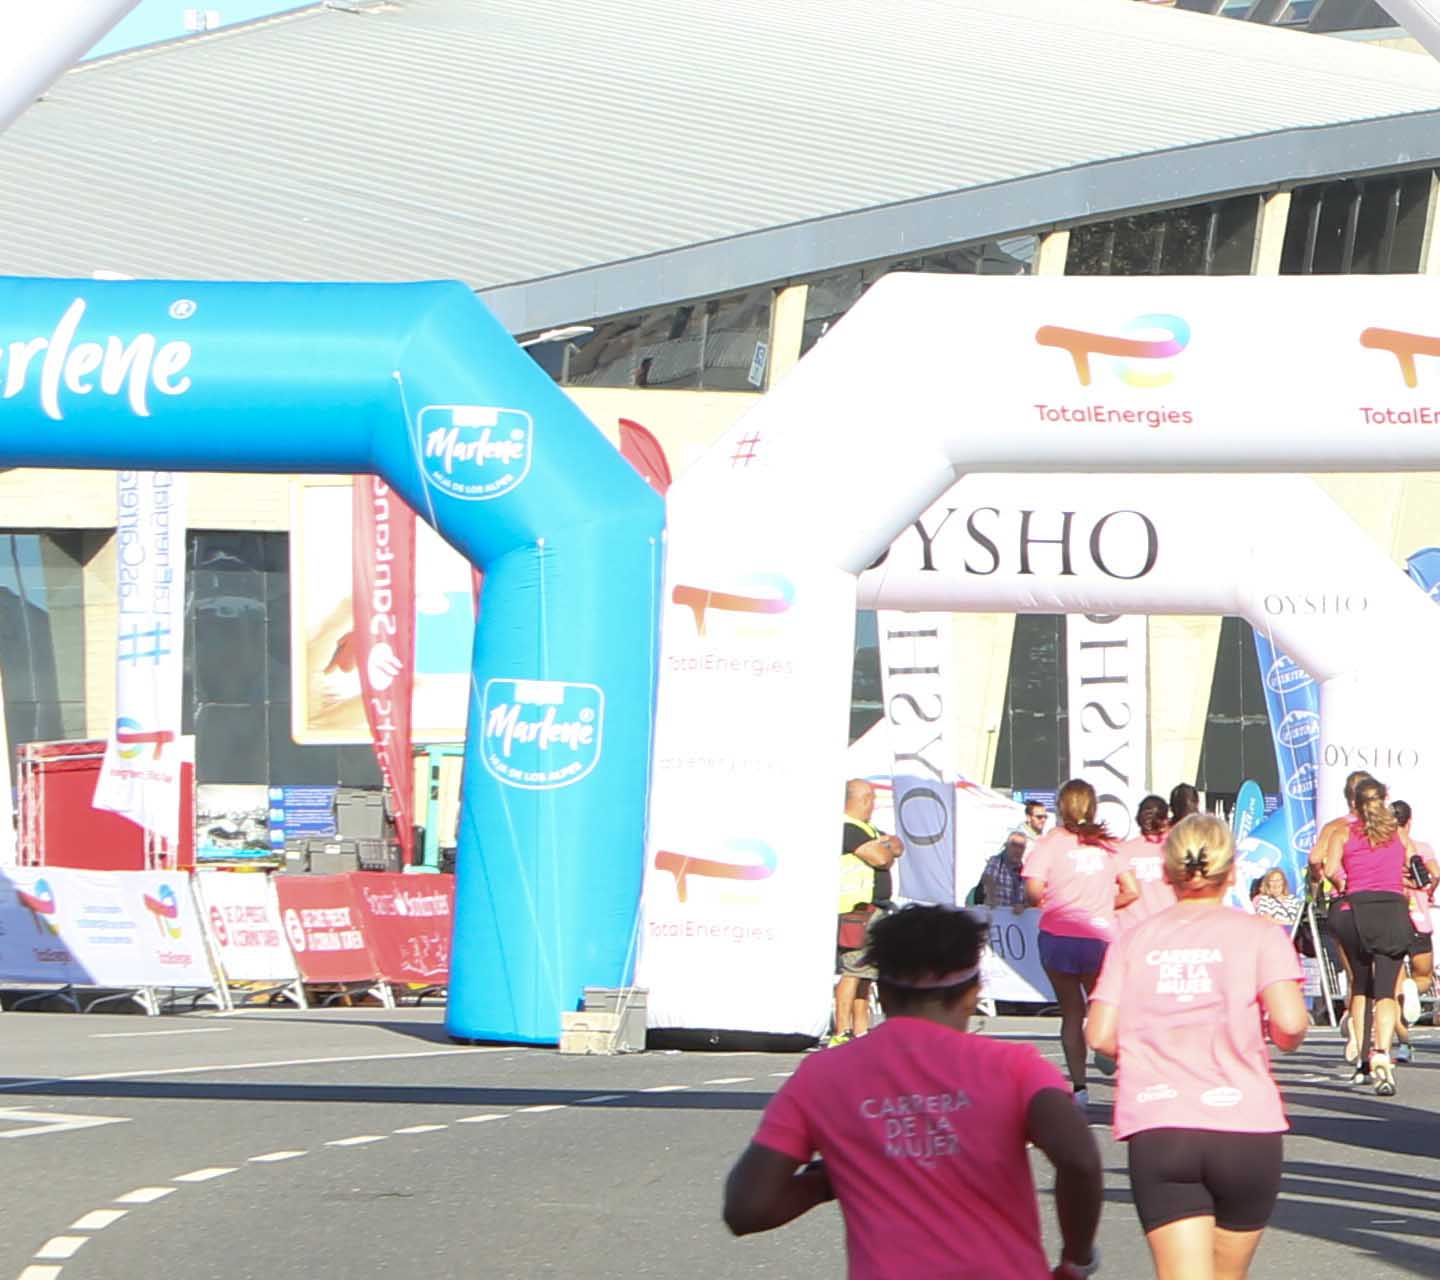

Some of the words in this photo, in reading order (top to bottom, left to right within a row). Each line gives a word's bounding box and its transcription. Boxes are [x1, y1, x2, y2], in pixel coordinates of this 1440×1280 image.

[0, 297, 192, 420] rlene
[1034, 404, 1193, 429] TotalEnergies
[425, 426, 525, 475] Marlene
[866, 507, 1160, 580] YSHO
[485, 703, 594, 758] Marlene
[886, 1116, 919, 1140] DE
